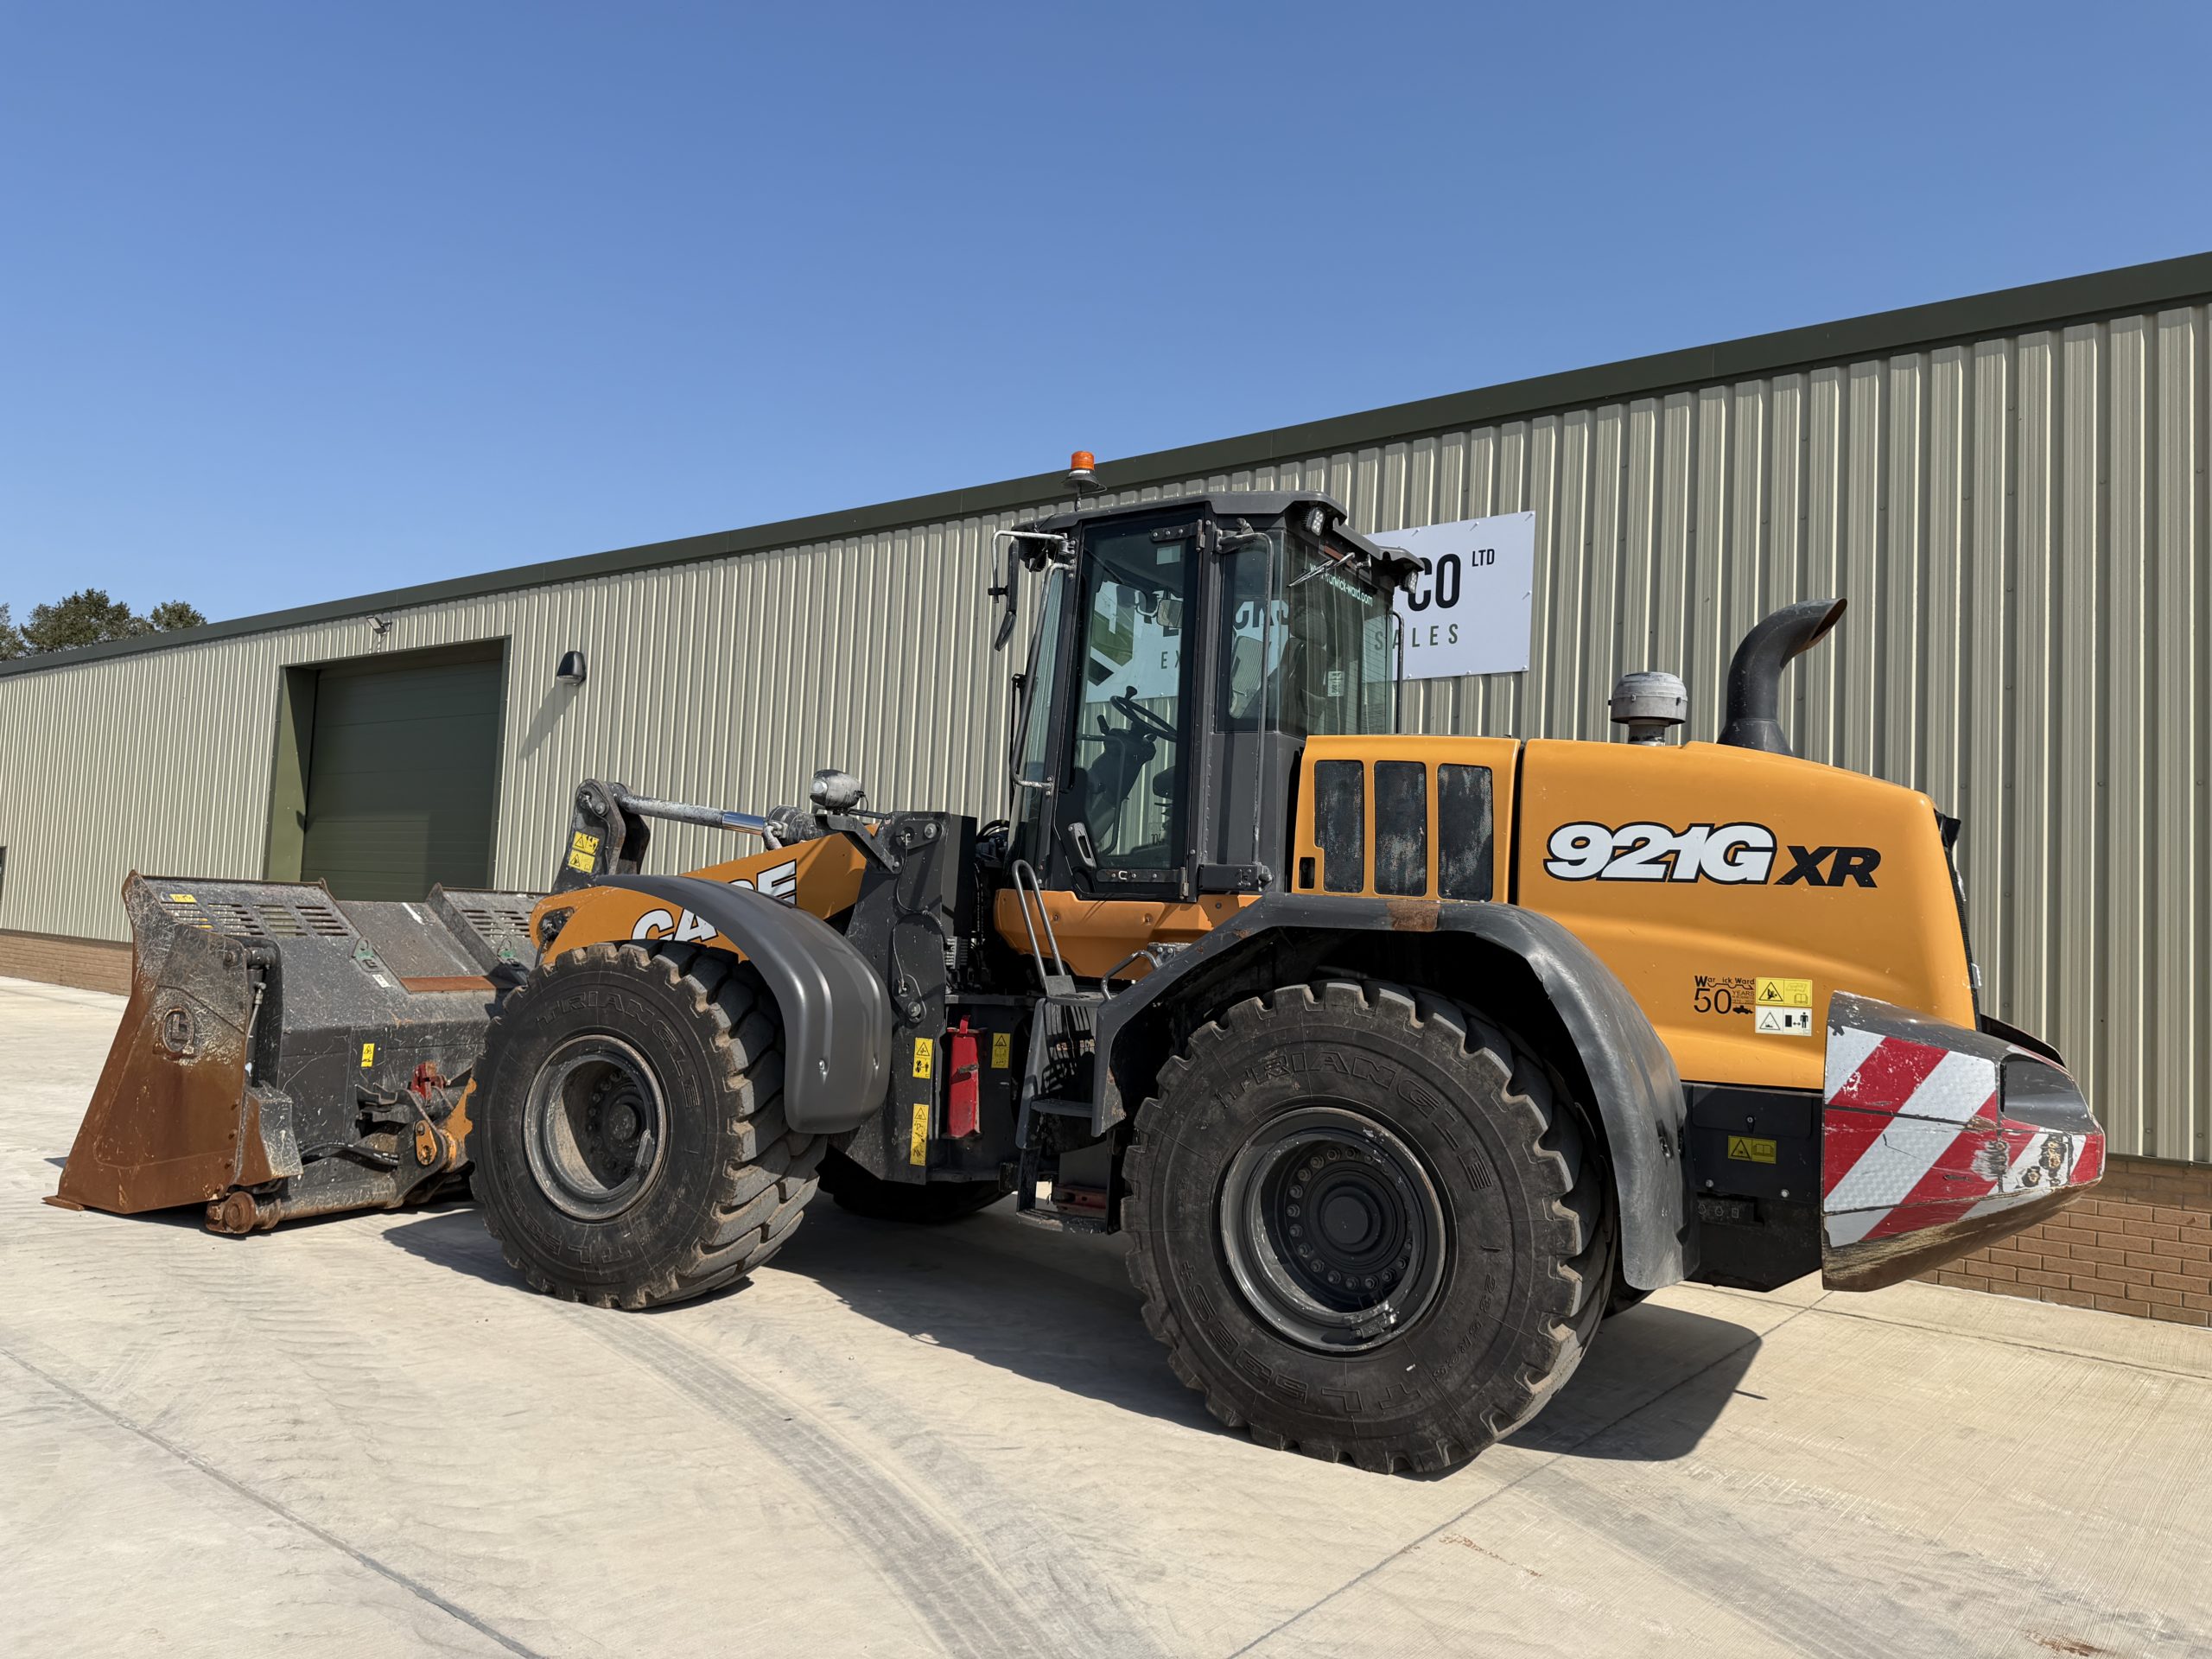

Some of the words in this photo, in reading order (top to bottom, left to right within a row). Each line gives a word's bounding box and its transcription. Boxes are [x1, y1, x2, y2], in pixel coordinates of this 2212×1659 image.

[1471, 549, 1495, 567] LTD
[1543, 822, 1777, 885] 921G
[1773, 845, 1881, 887] XR
[631, 858, 797, 941] CAE
[1694, 988, 1732, 1014] 50
[535, 991, 700, 1109] TRIANGLE
[1213, 1051, 1493, 1191] TRIANGLE
